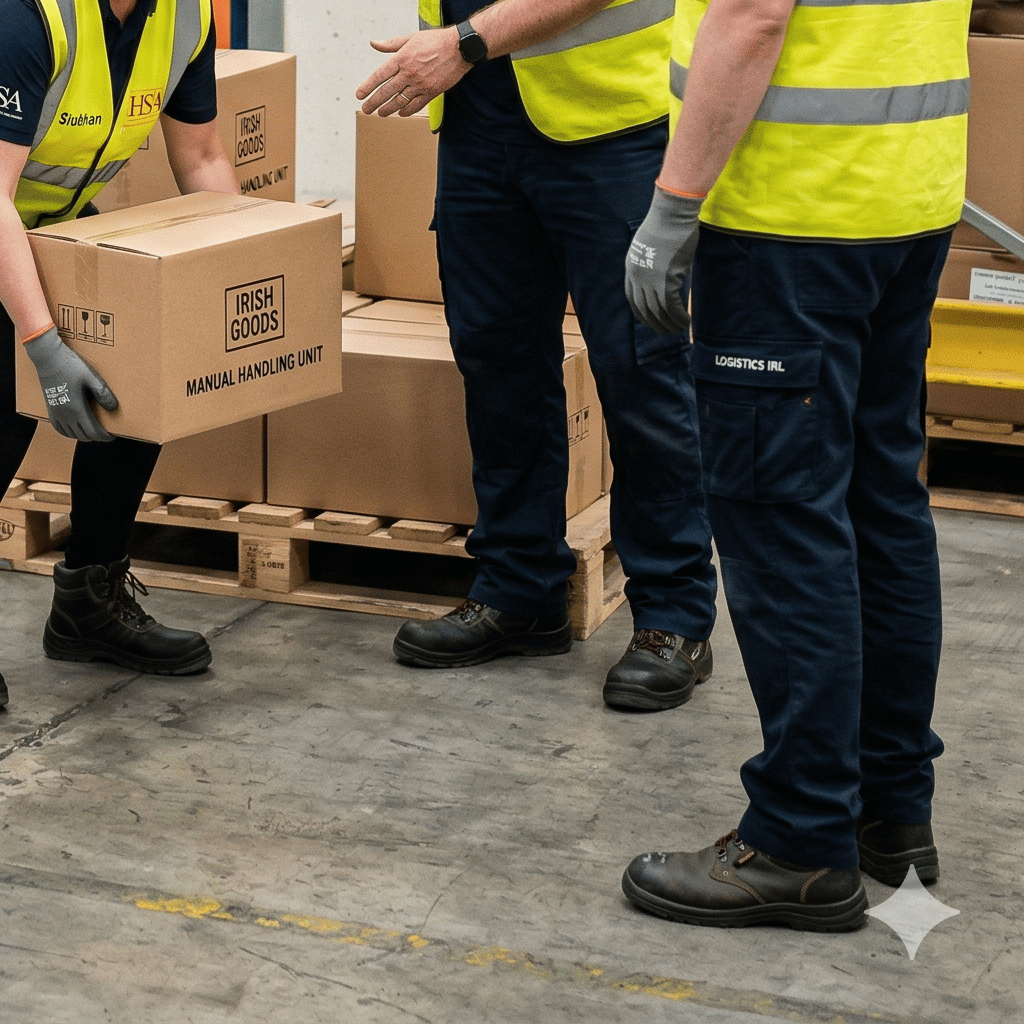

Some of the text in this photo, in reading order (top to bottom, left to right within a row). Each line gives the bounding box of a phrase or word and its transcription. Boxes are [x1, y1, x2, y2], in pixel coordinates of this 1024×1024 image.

[128, 91, 162, 117] HSA
[237, 133, 264, 158] GOODS
[236, 285, 274, 316] IRISH
[230, 309, 279, 342] GOODS
[186, 344, 324, 398] MANUAL HANDLING UNIT
[715, 354, 785, 372] LOGISTICS IRL
